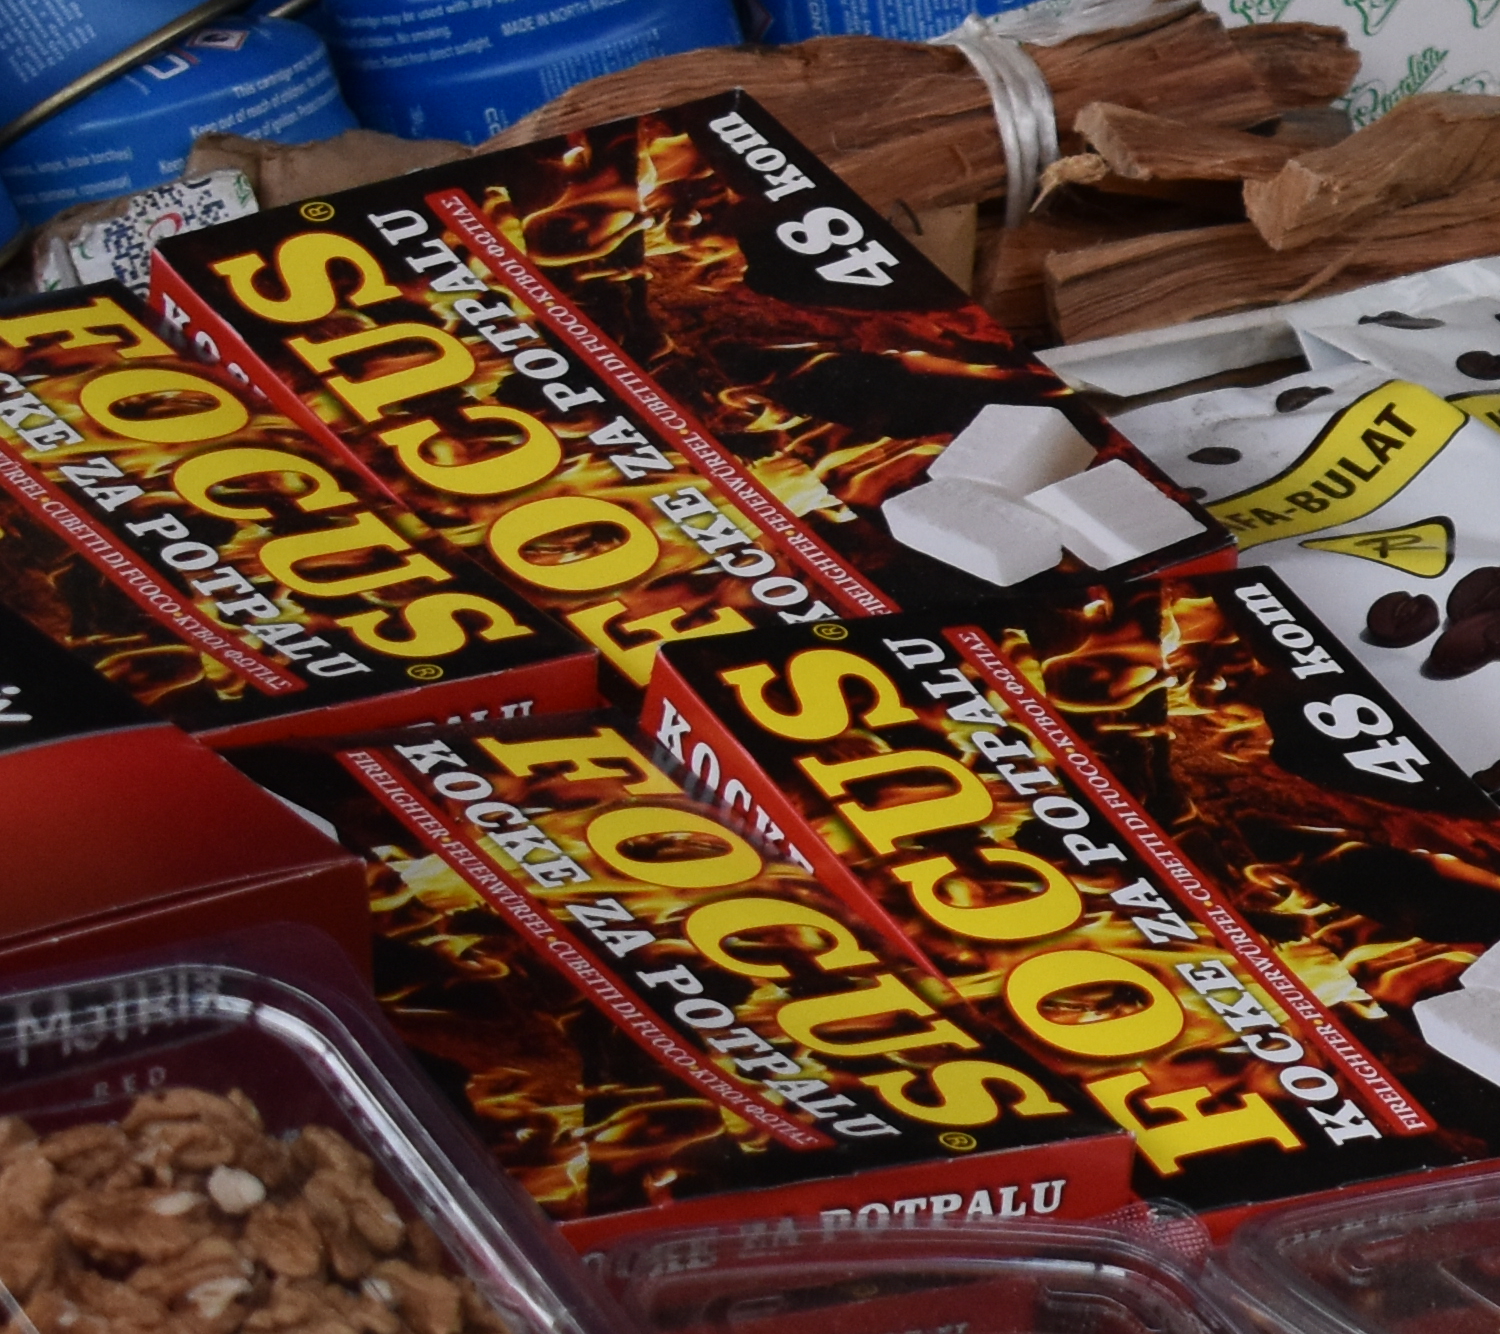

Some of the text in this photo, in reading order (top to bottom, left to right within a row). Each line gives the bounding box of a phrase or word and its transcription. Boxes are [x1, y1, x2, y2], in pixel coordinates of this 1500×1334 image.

[707, 111, 904, 288] 48 kom
[0, 295, 536, 659] FOCUS
[43, 500, 179, 616] CUBETTI DI FUOCO
[60, 457, 373, 677] ZA POTPALU
[212, 229, 753, 686] FOCUS
[367, 208, 842, 624] KOCKE ZA POTPALU
[548, 306, 893, 616] FIRELIGHTER FEUERWÜRFEL CUBETTI DI FUOCO
[1219, 401, 1420, 534] AFA-BULAT
[1362, 533, 1424, 562] R
[1234, 580, 1432, 787] 48 kom
[347, 750, 696, 1071] FIRELIGHTER FEUERWÜRFEL CUBETTI DI FUOCO
[394, 738, 905, 1145] KOCKE ZA POTPALU
[470, 726, 1072, 1127] FOCUS
[722, 646, 1303, 1178] FOCUS
[885, 635, 1383, 1147] KOCKE ZA POTPALU
[1067, 752, 1427, 1131] FIRELIGHTER FEUERWÜRFEL CUBETTI FUOCO
[819, 1179, 1069, 1245] POTPALU
